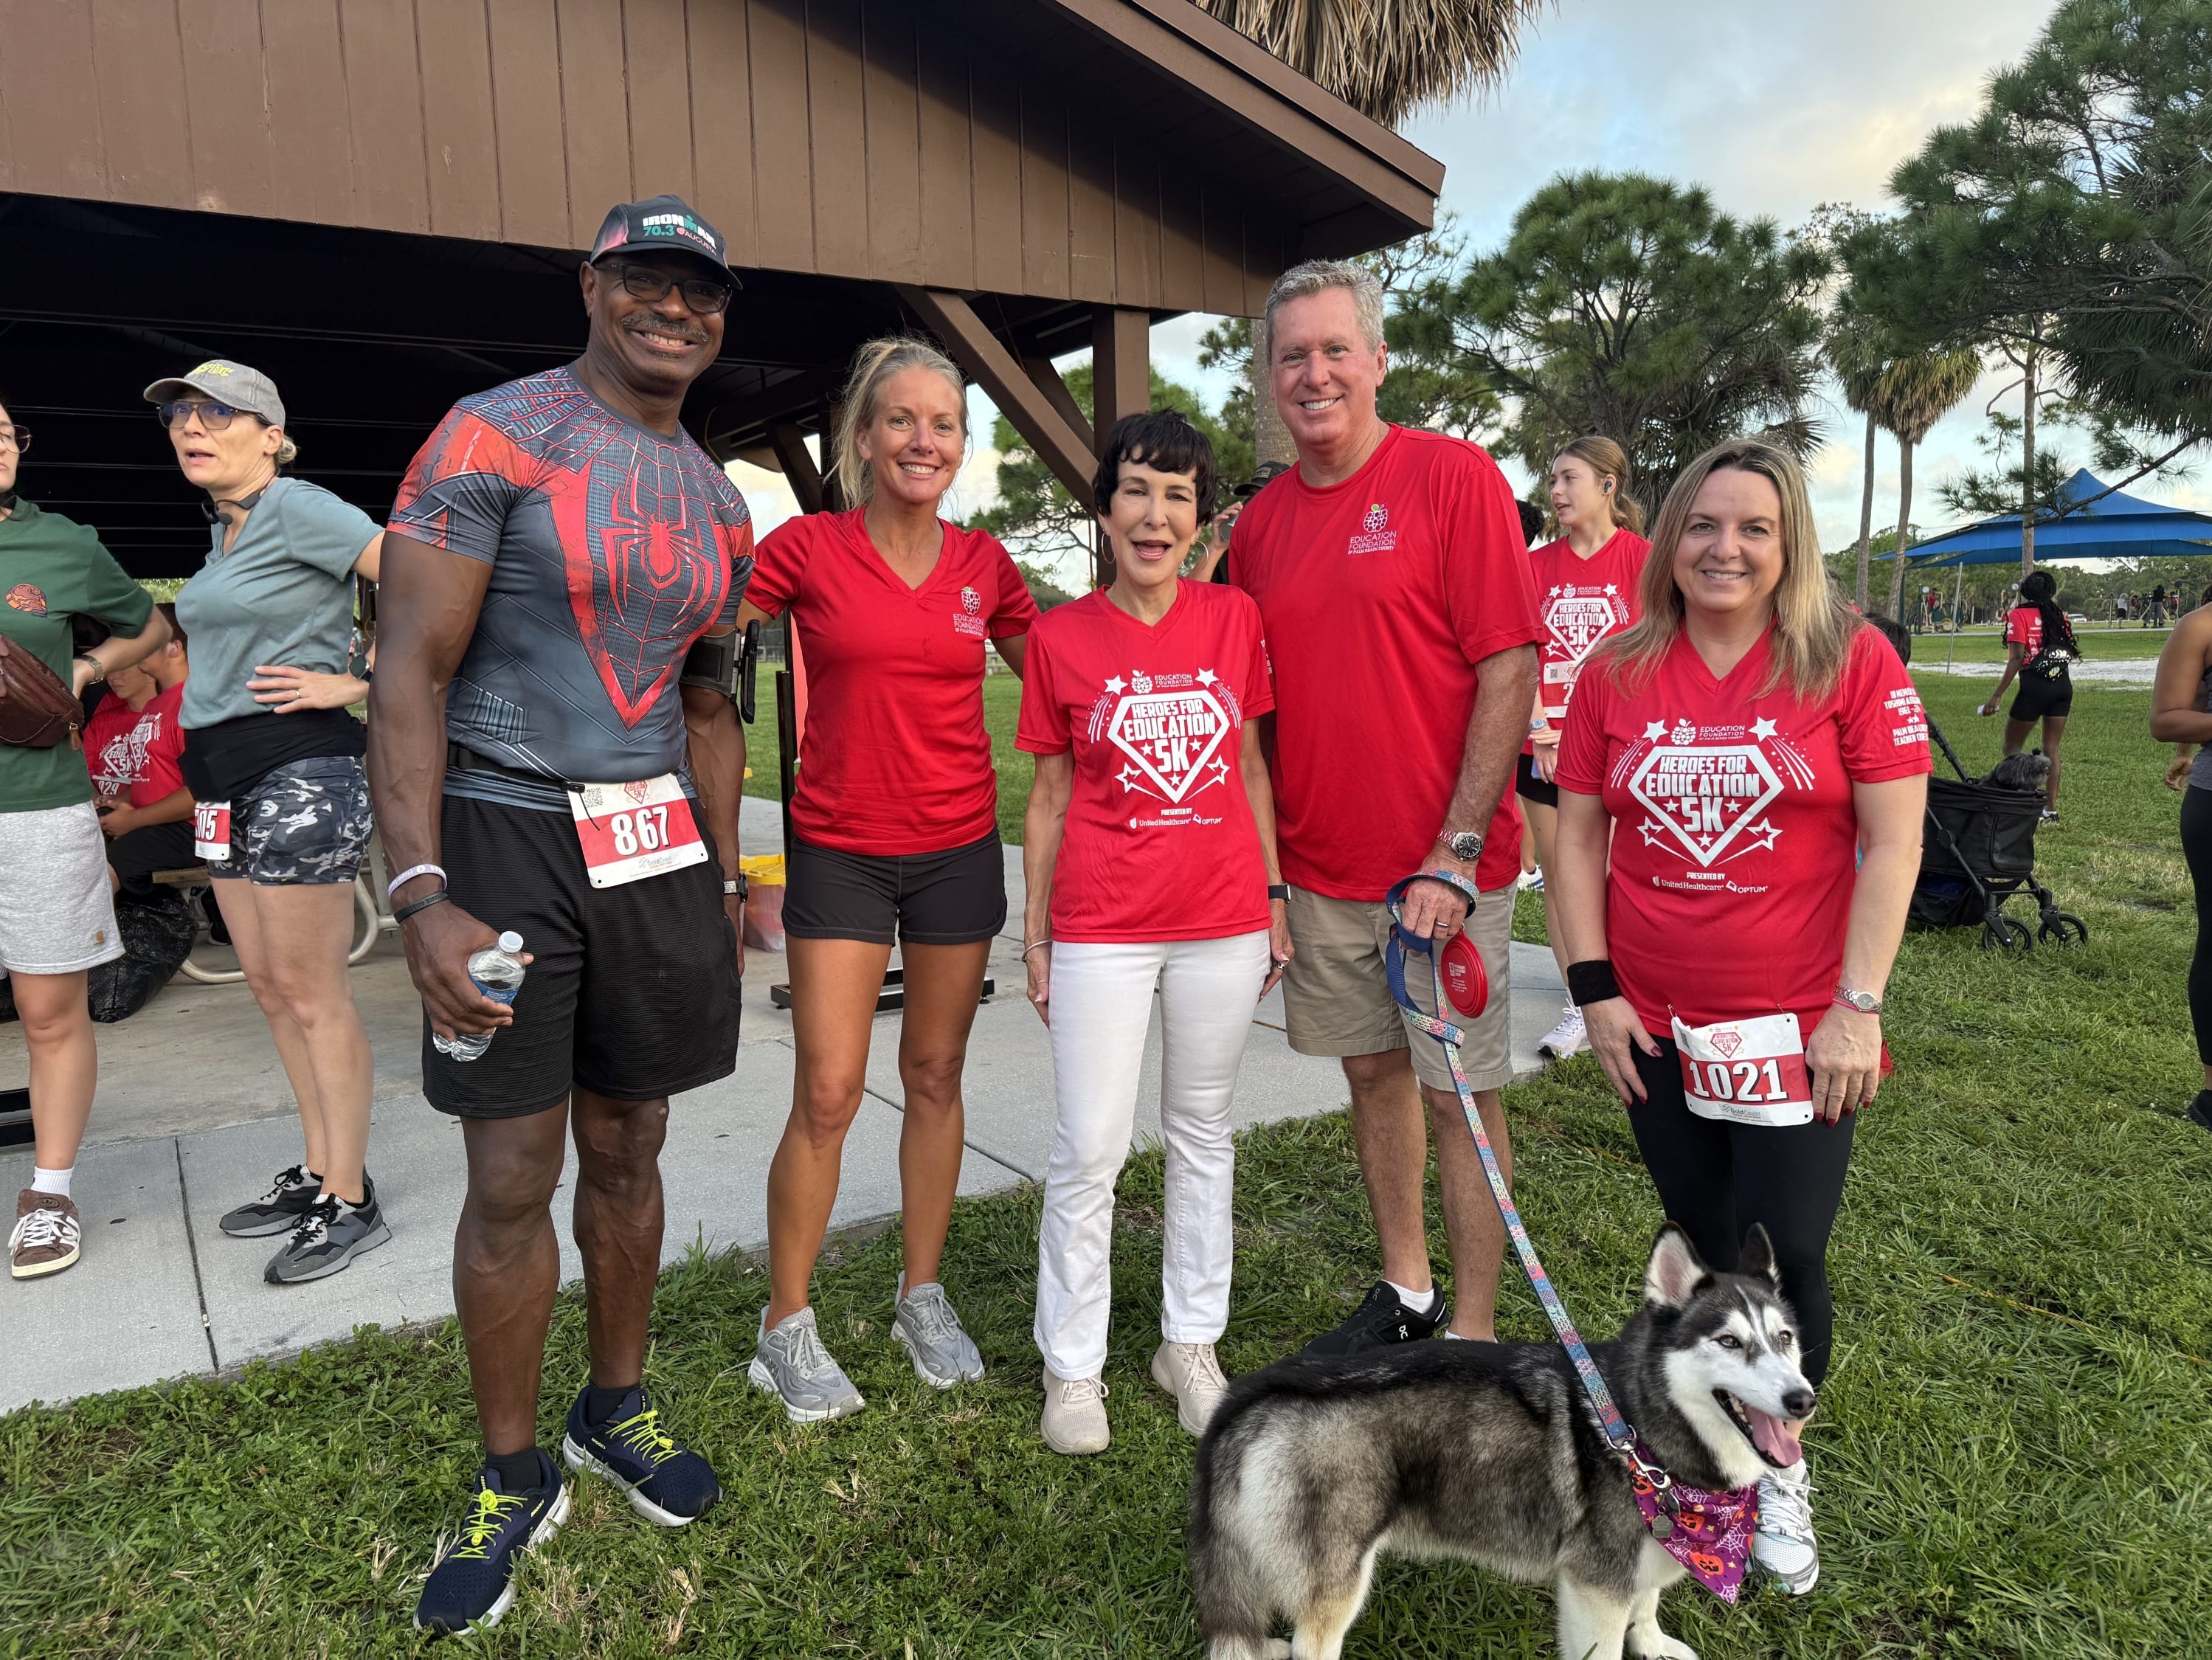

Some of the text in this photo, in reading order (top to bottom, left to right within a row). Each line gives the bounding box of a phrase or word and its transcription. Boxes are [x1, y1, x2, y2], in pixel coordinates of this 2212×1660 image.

[643, 214, 716, 249] IRONMAN
[643, 224, 716, 256] 70.3 AUGUSTA
[1349, 539, 1396, 550] FOUNDATION
[1350, 531, 1397, 544] EDUCATION
[1559, 604, 1601, 614] HEROES FOR
[1553, 613, 1606, 626] EDUCATION
[1569, 626, 1589, 646] 5K
[1131, 699, 1204, 719] HEROES FOR
[1123, 712, 1216, 742] EDUCATION
[1893, 727, 1908, 737] PALM
[1893, 734, 1916, 747] TEACHER
[1155, 737, 1190, 773] 5K
[1660, 755, 1746, 773] HEROES FOR
[634, 789, 643, 798] 5K
[1646, 774, 1760, 797] EDUCATION
[1681, 797, 1724, 832] 5K
[611, 805, 669, 856] 867
[647, 855, 673, 866] GoldCoast
[1722, 1043, 1732, 1052] 5K
[1689, 1059, 1788, 1102] 1021
